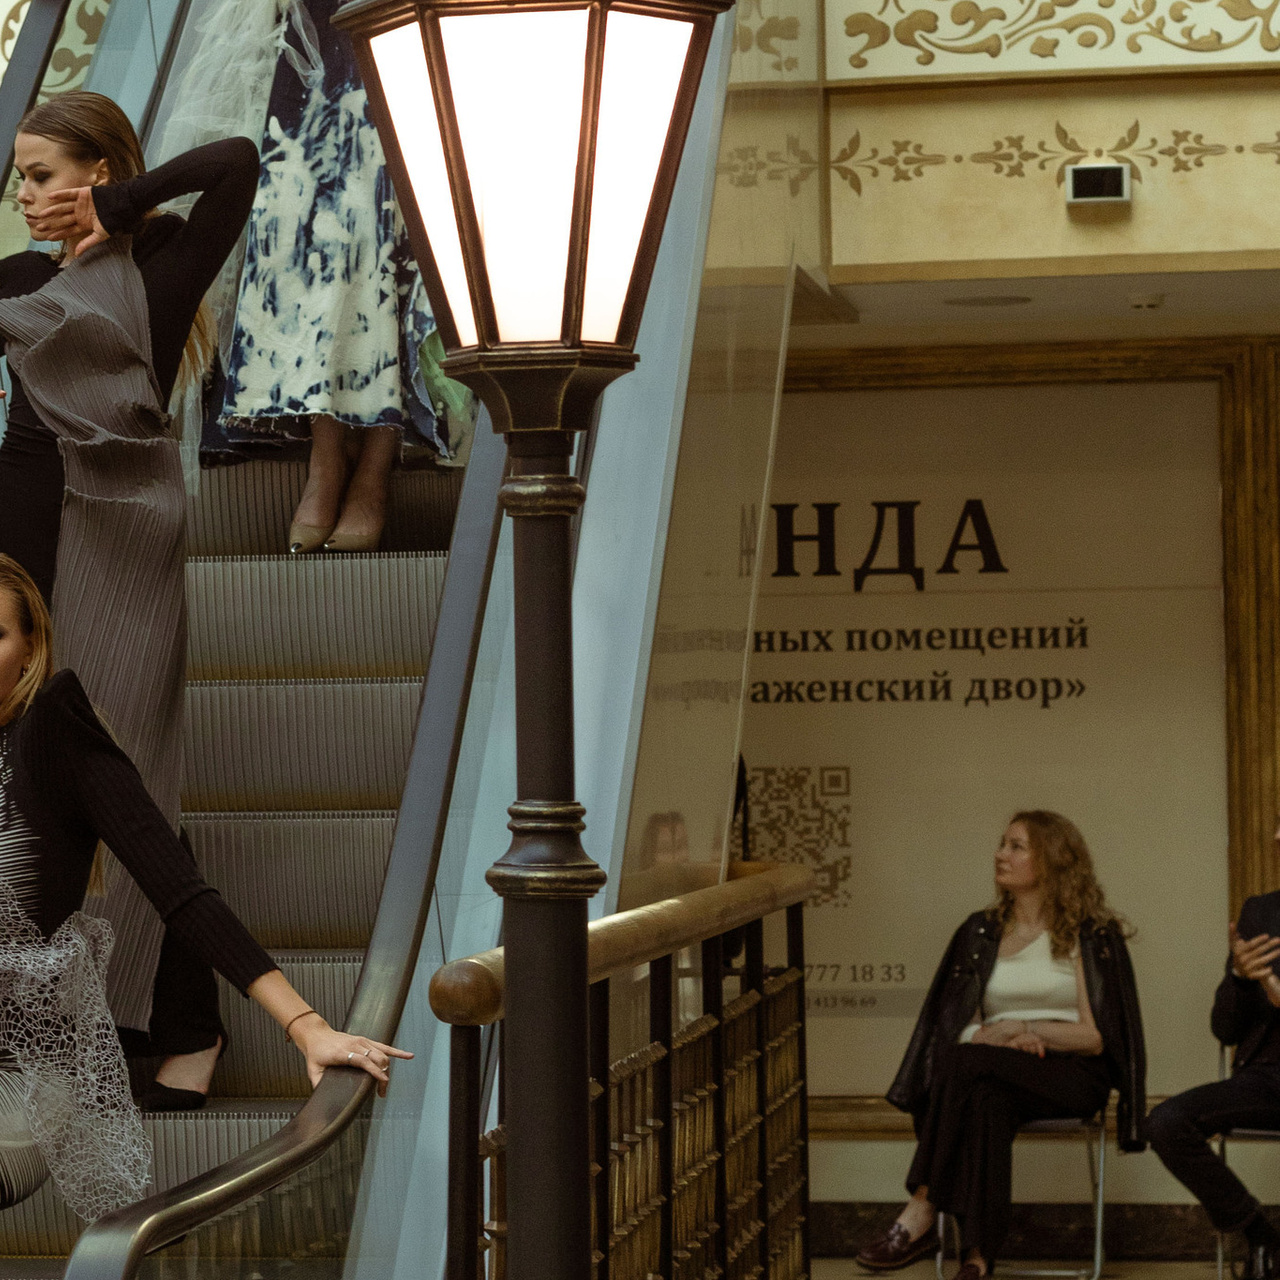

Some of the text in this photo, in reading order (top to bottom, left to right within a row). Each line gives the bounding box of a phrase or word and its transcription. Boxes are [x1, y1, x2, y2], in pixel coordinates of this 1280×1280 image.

[771, 498, 1009, 593] НДА
[753, 629, 834, 653] ных
[845, 619, 1089, 656] помещений
[750, 670, 953, 704] аженский
[964, 675, 1086, 708] двор»
[850, 963, 874, 983] 18
[881, 963, 906, 983] 33
